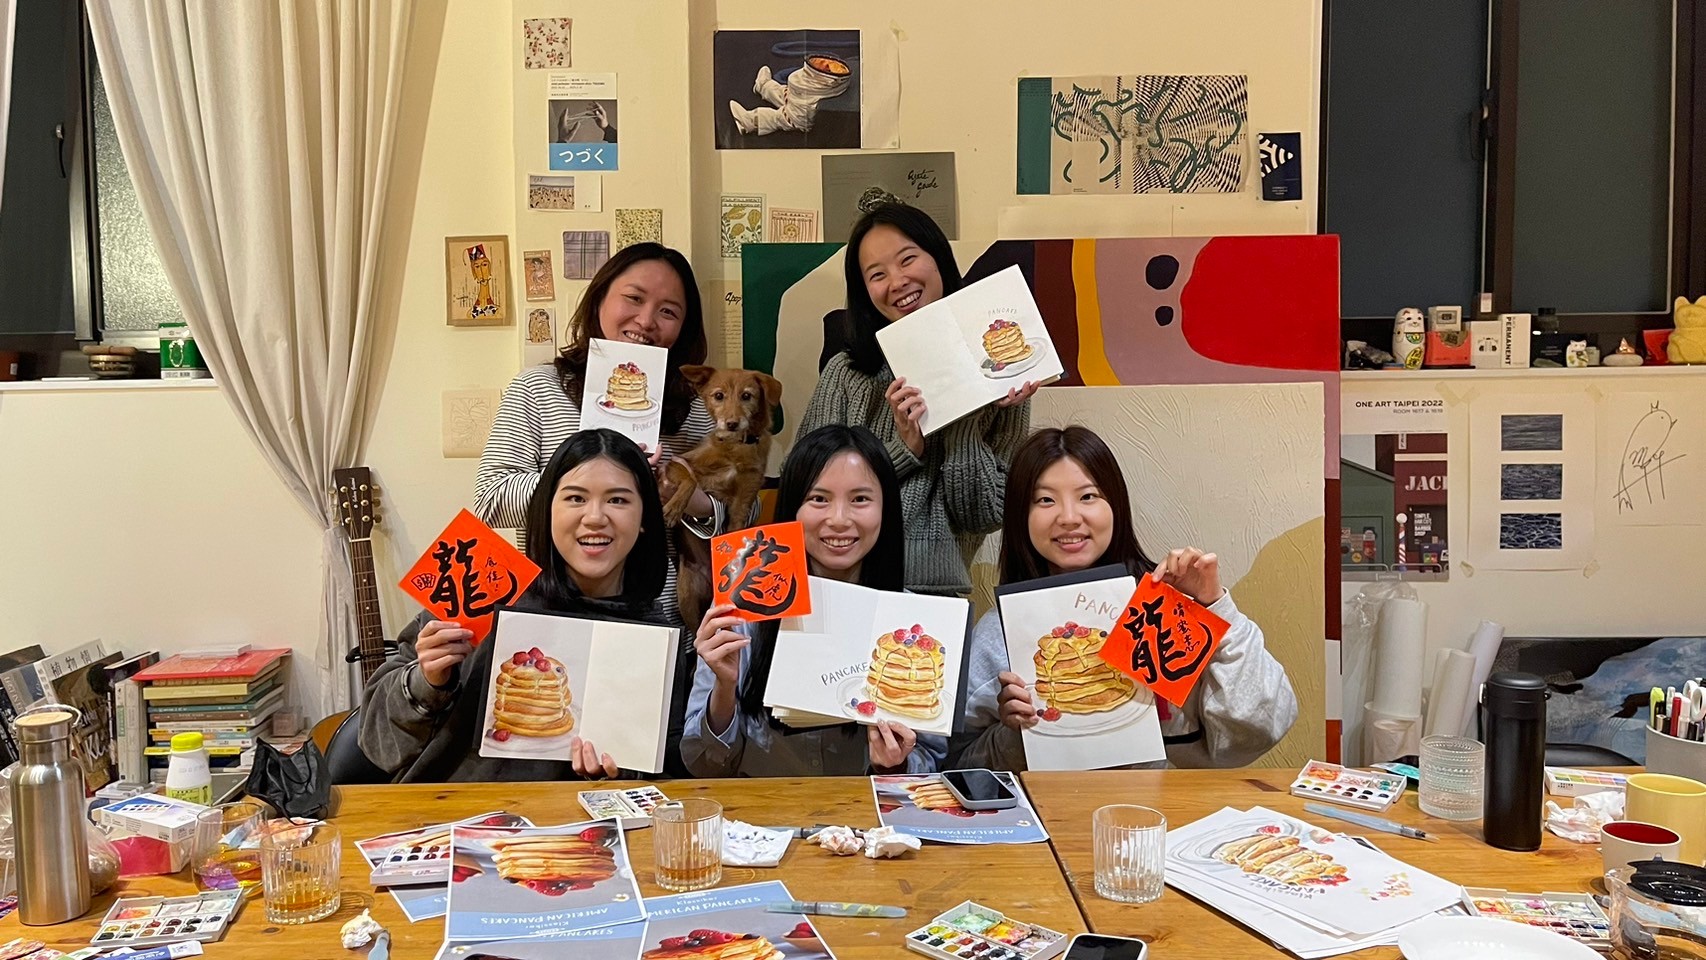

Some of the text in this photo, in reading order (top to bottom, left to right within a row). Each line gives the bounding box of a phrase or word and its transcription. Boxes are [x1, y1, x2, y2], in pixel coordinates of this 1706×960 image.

[558, 148, 604, 165] つづく
[429, 538, 518, 618] 龍
[1123, 595, 1213, 685] 龍
[820, 661, 869, 686] PANCAKE
[480, 907, 609, 924] AMERICAN PANCAKES
[648, 896, 761, 916] MERICAN PANCAKES
[525, 921, 569, 929] Klassiker
